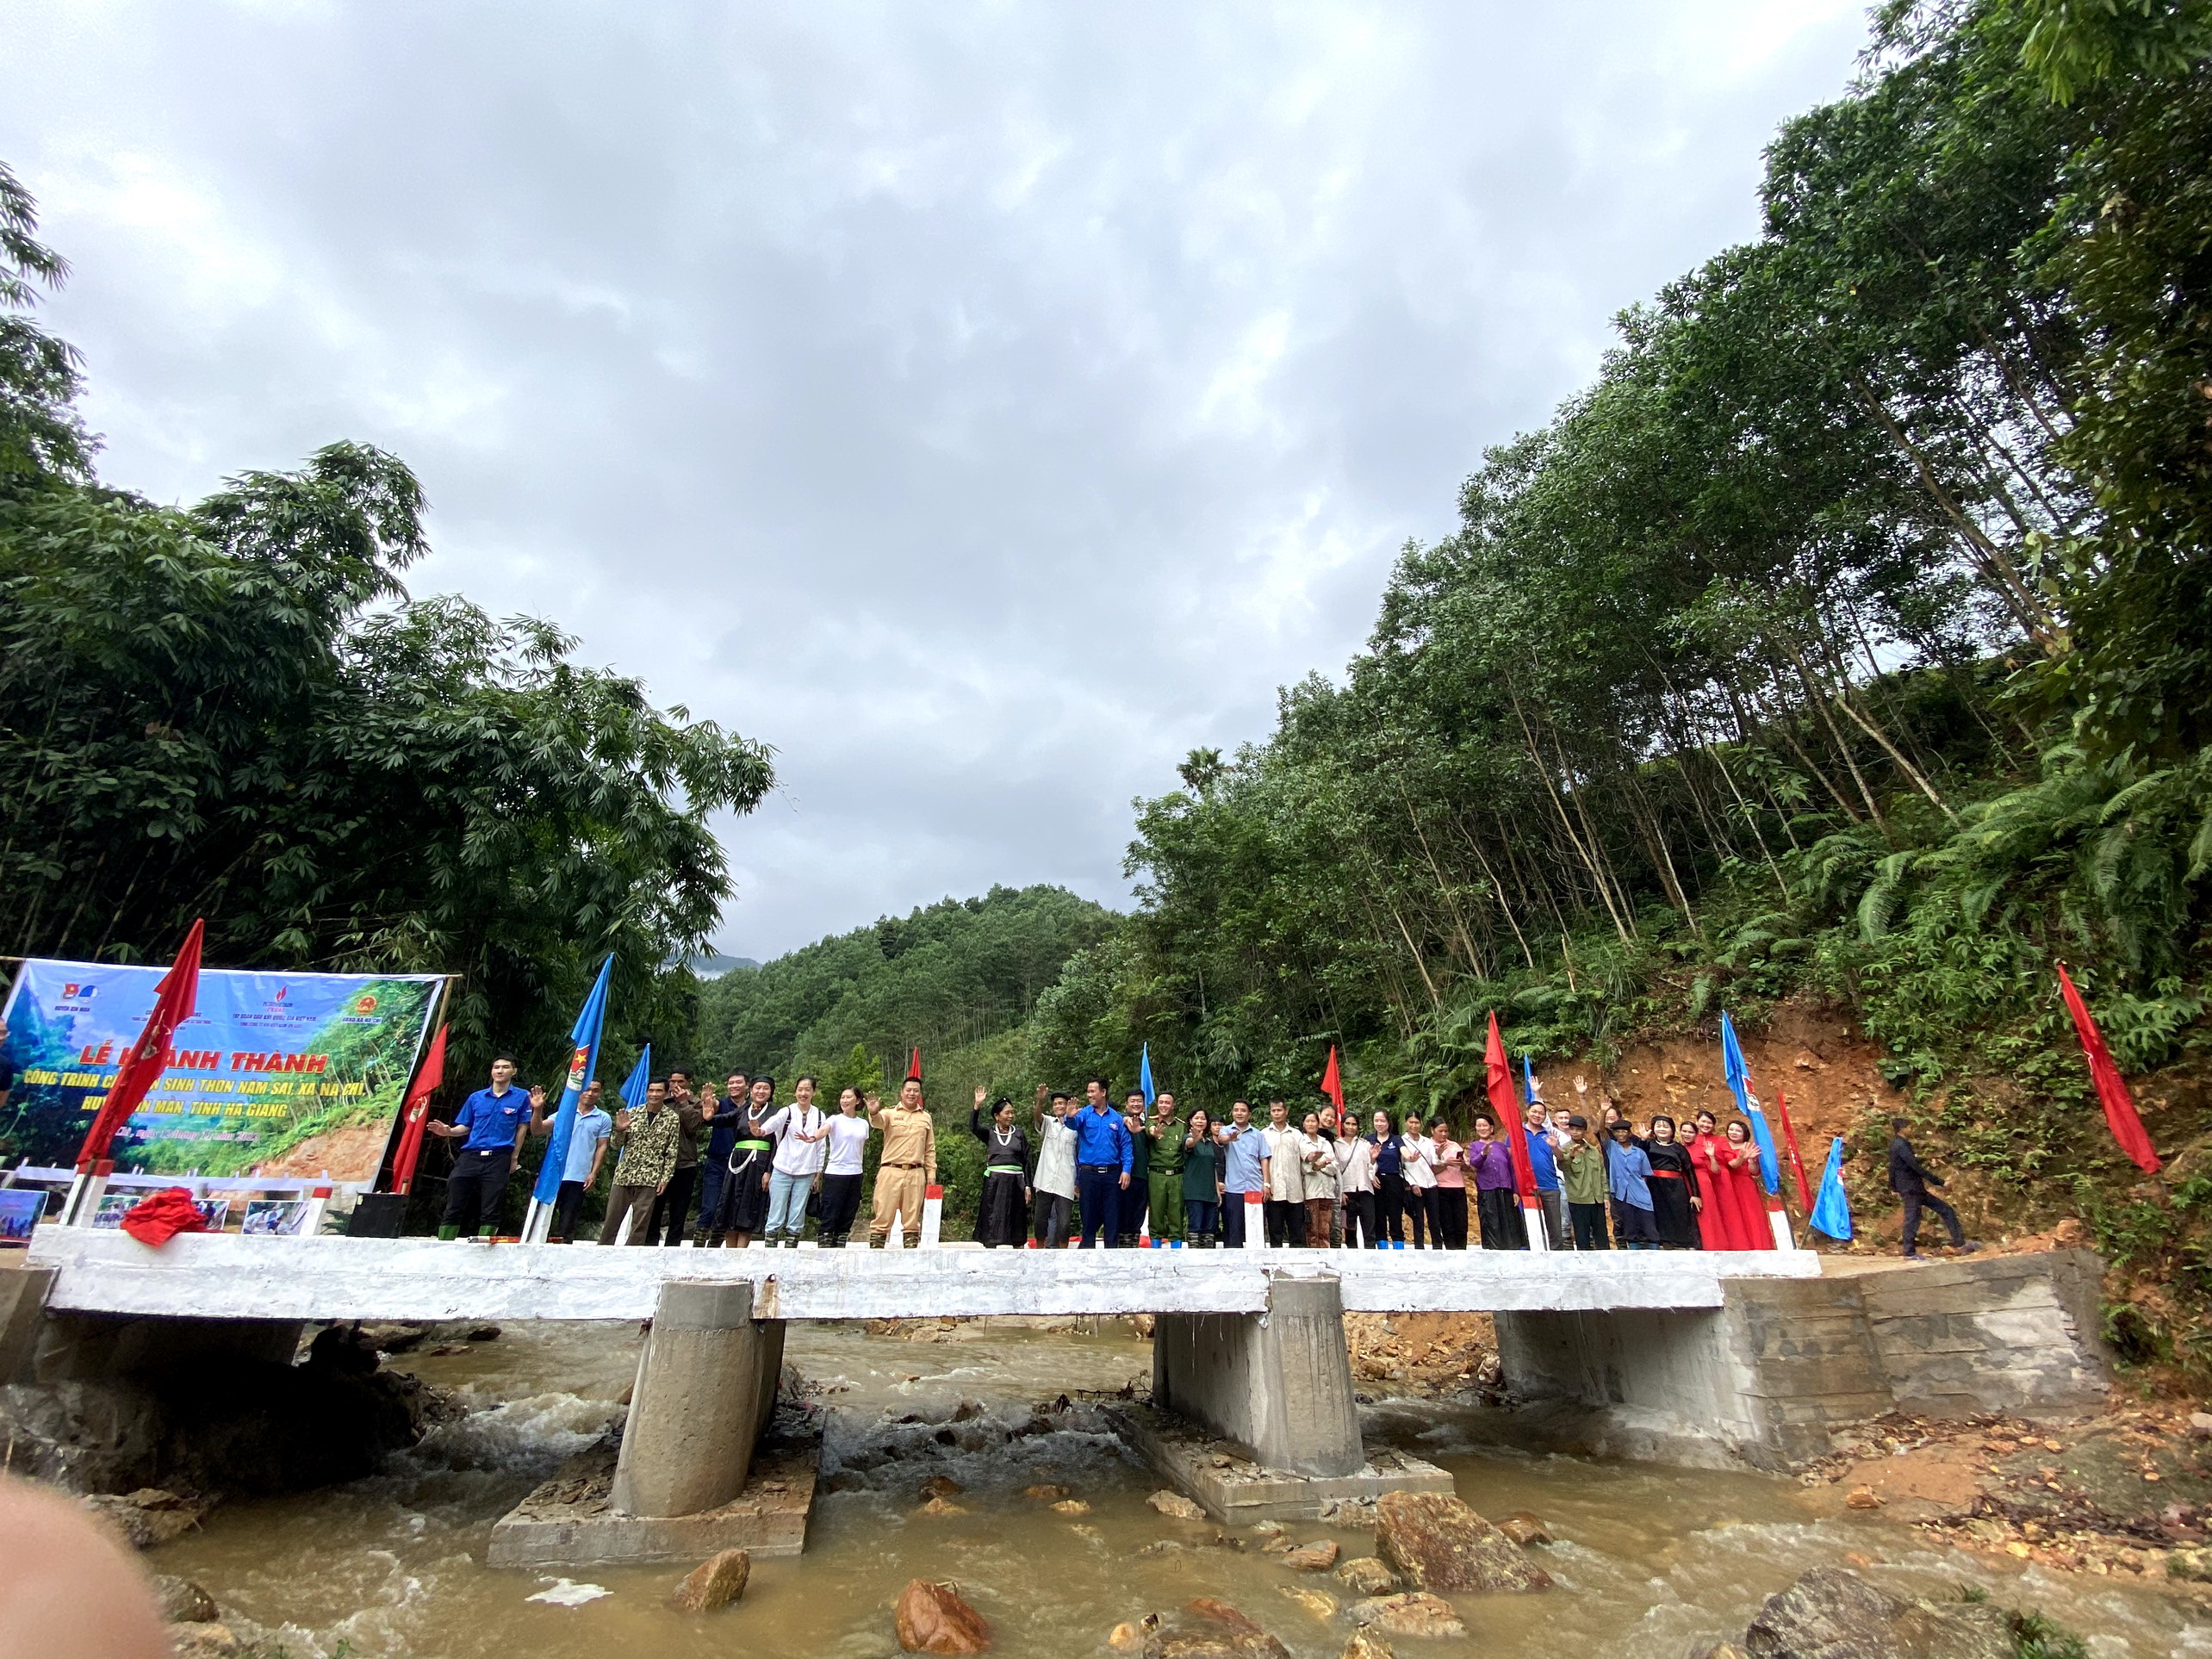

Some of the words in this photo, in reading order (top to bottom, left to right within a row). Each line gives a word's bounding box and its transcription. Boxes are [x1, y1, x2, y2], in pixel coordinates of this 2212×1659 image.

[231, 1050, 328, 1073] THÀNH
[24, 1068, 58, 1084] CÔNG
[61, 1072, 100, 1086] TRÌNH
[163, 1077, 196, 1091] SINH
[198, 1077, 236, 1093] THÔN
[245, 1103, 288, 1117] GIANG
